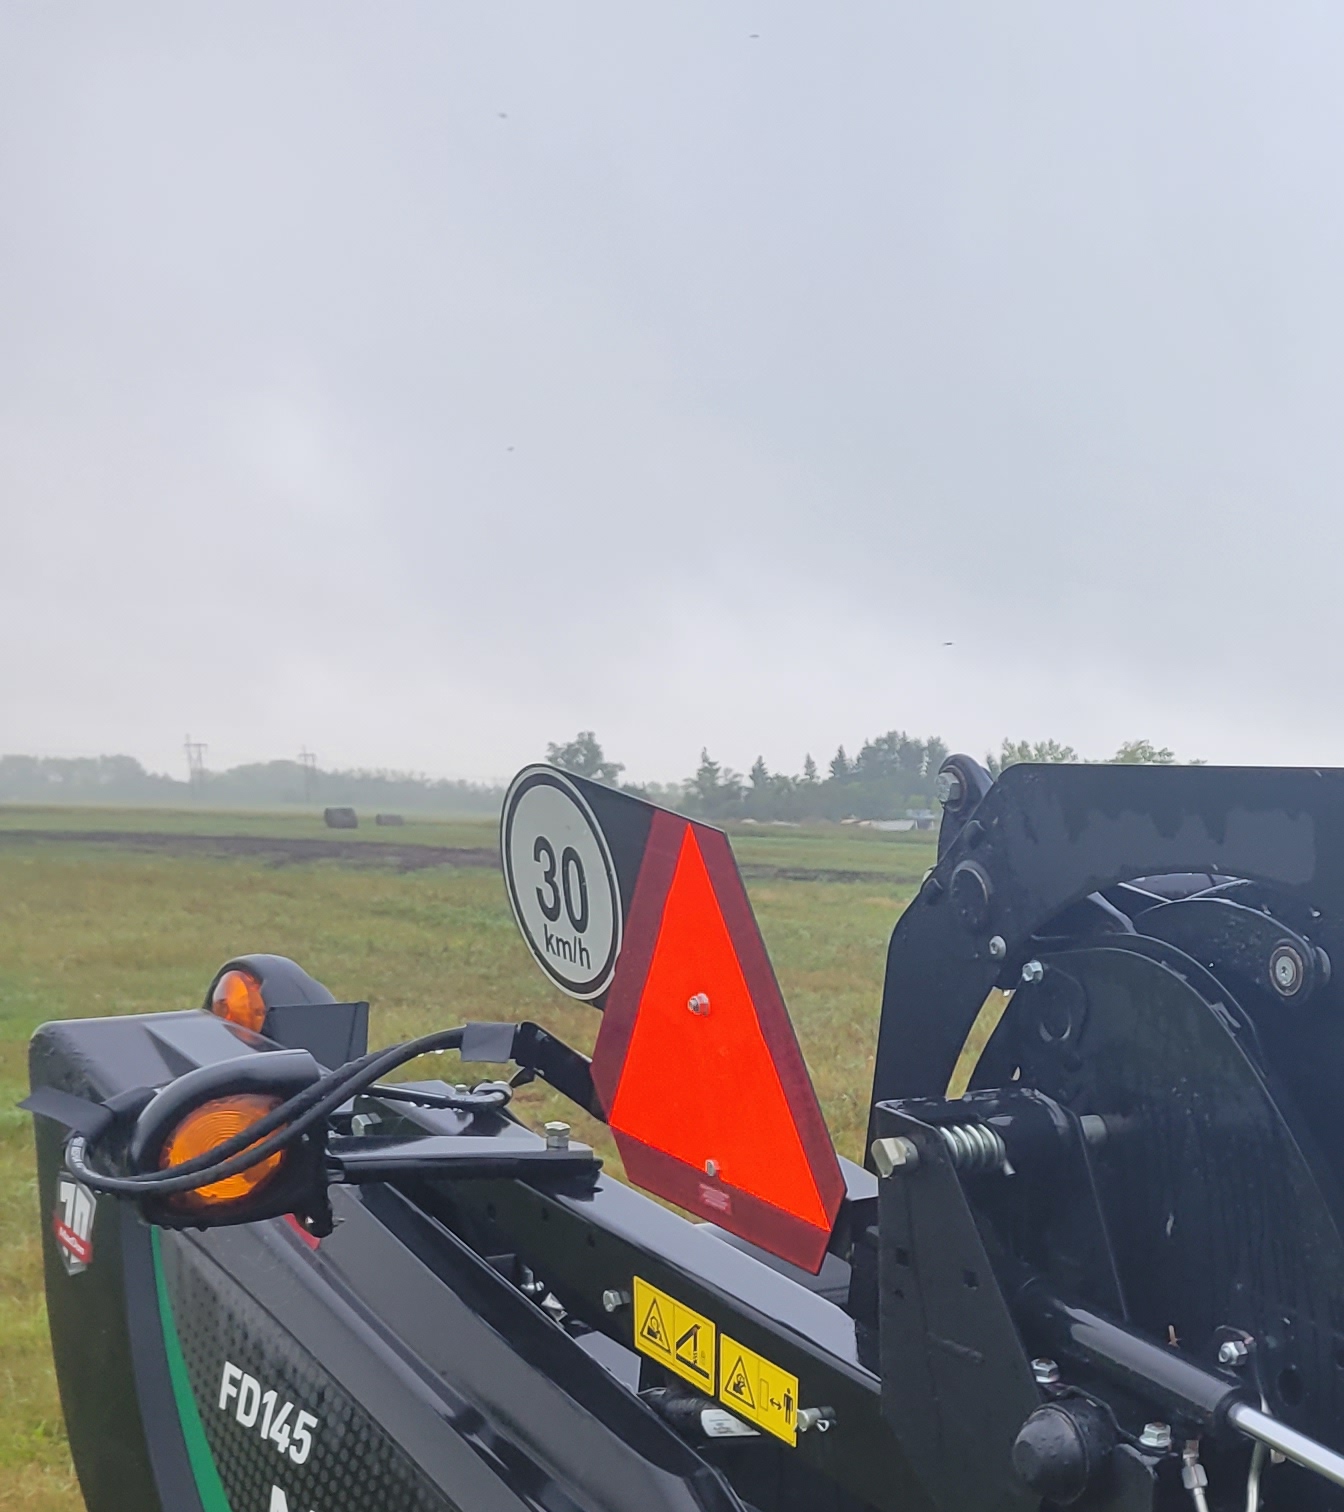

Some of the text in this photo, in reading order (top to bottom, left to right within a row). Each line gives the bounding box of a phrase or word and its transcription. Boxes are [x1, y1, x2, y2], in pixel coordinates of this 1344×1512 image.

[533, 835, 589, 934] 30
[543, 922, 592, 970] km/h
[218, 1360, 319, 1465] FD145
